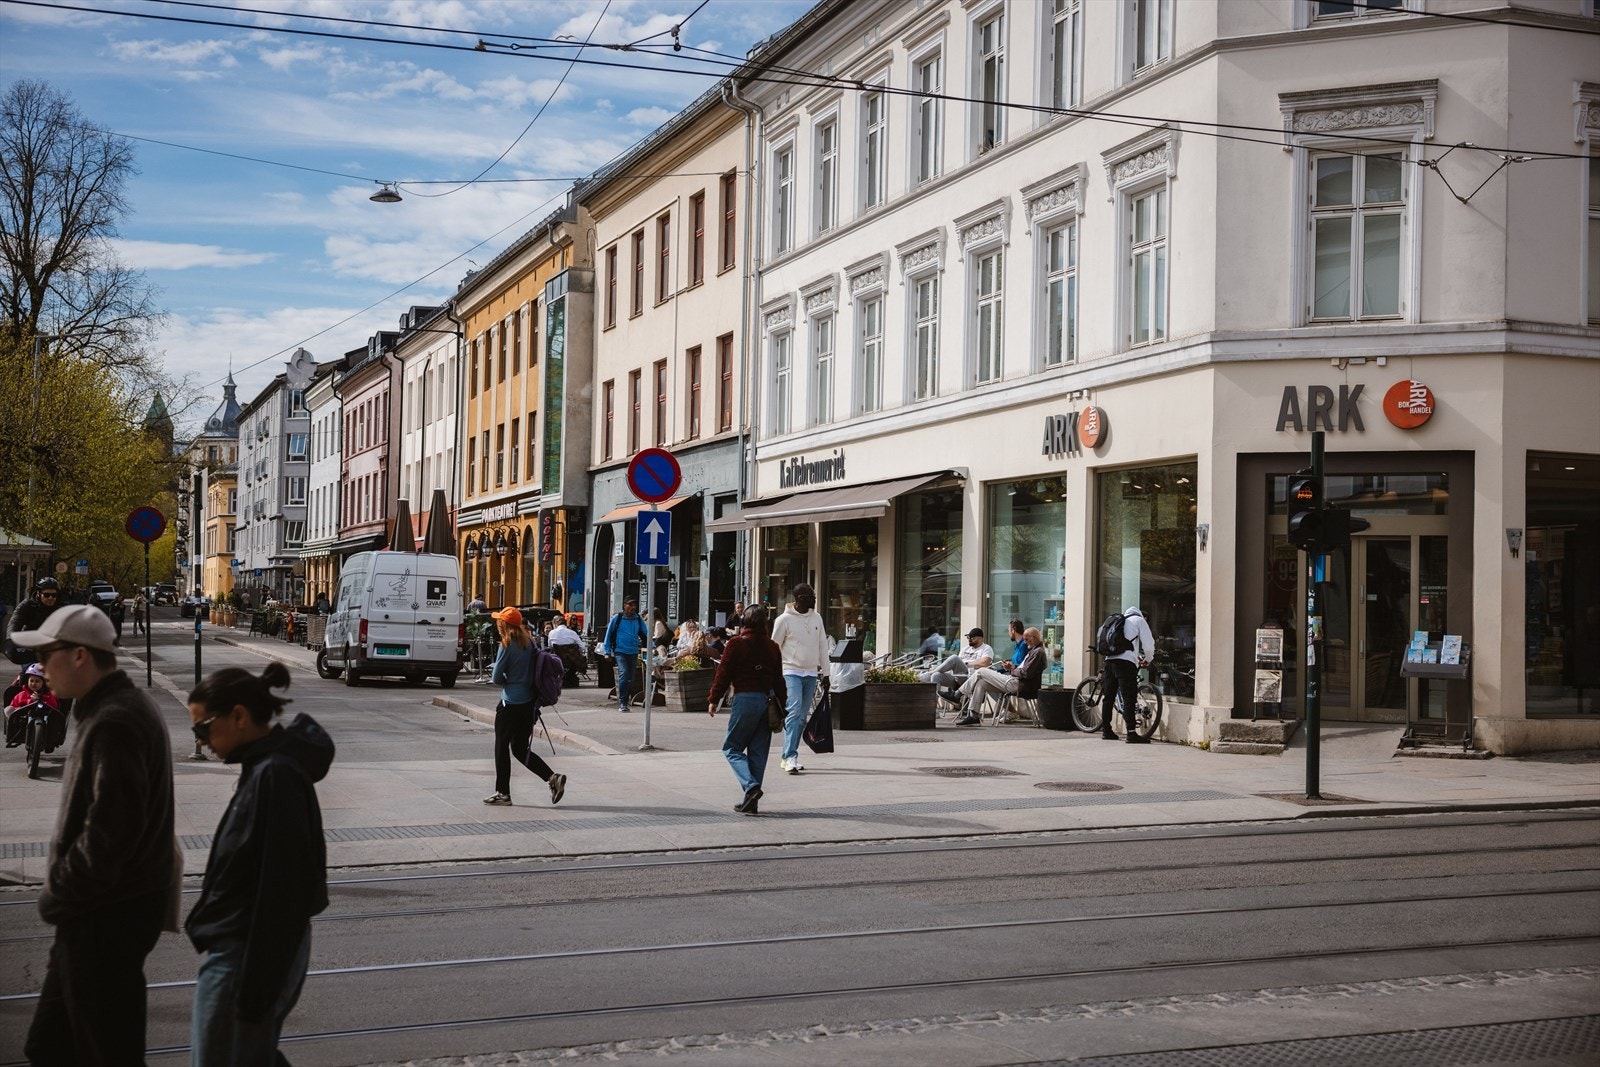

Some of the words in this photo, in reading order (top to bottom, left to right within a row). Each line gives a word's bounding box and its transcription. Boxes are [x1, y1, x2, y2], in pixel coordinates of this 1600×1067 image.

[1276, 384, 1365, 431] ARK
[1410, 380, 1427, 407] ARK
[1042, 411, 1079, 455] ARK
[780, 448, 845, 489] Kaffebrenneriet
